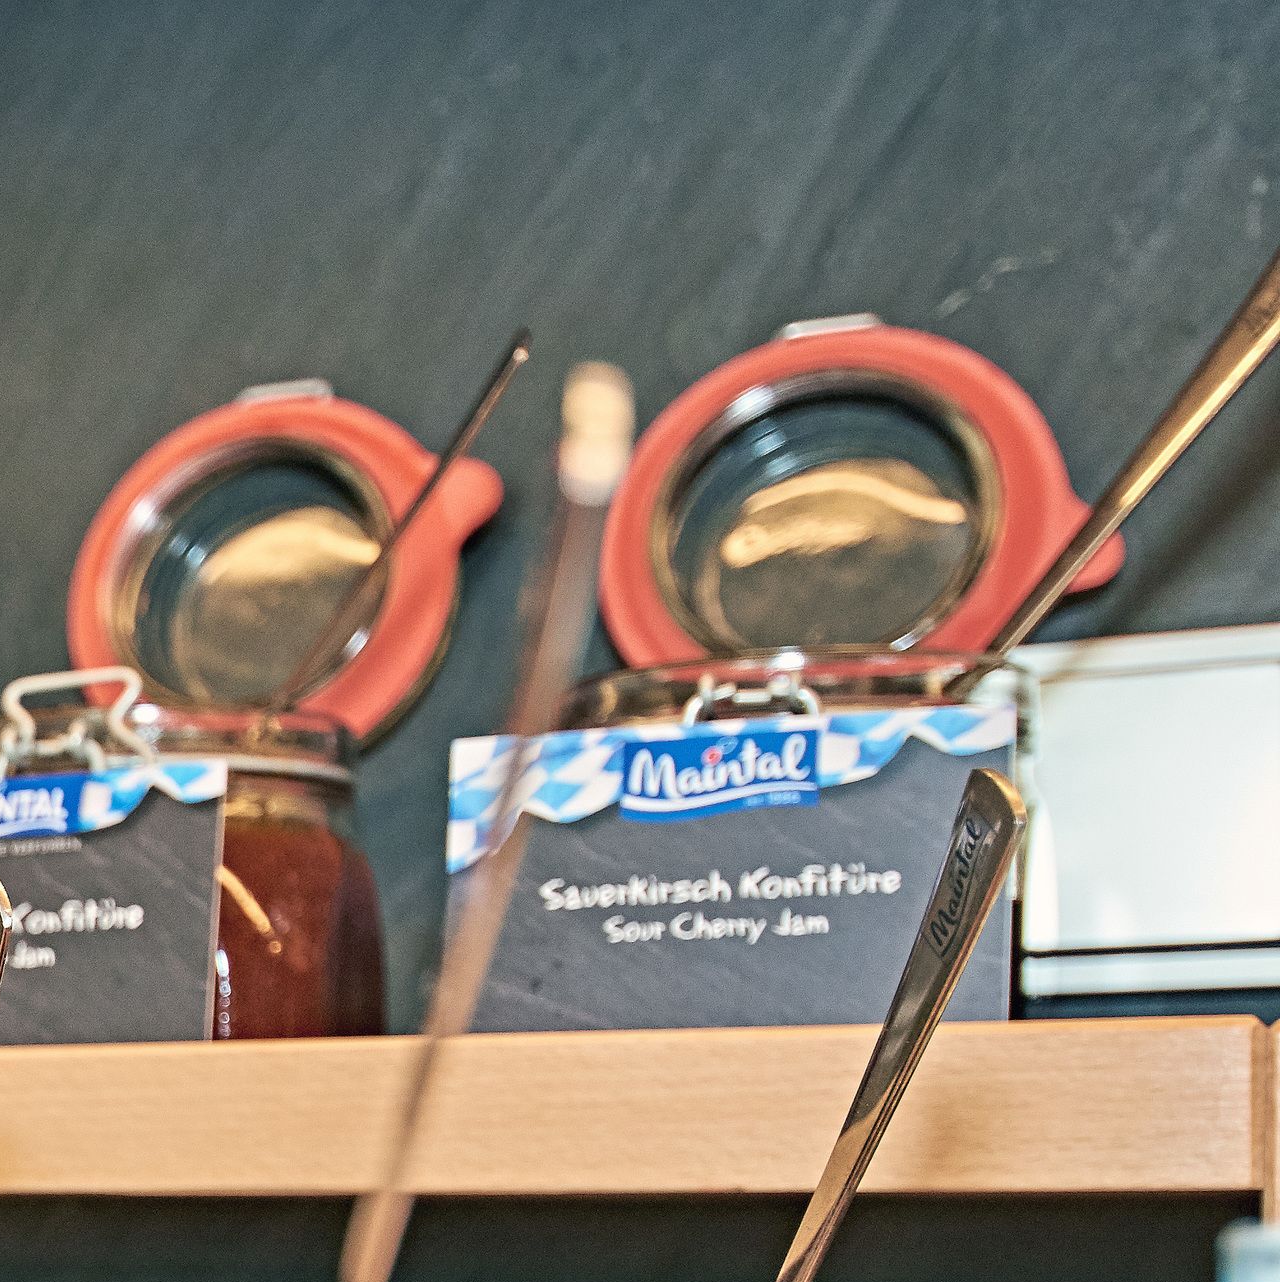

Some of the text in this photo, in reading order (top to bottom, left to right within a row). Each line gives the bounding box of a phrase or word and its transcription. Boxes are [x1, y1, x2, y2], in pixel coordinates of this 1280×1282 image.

[627, 733, 811, 801] Maintal
[738, 862, 902, 900] Konfitüre
[602, 907, 830, 946] Sour Cherry Jam
